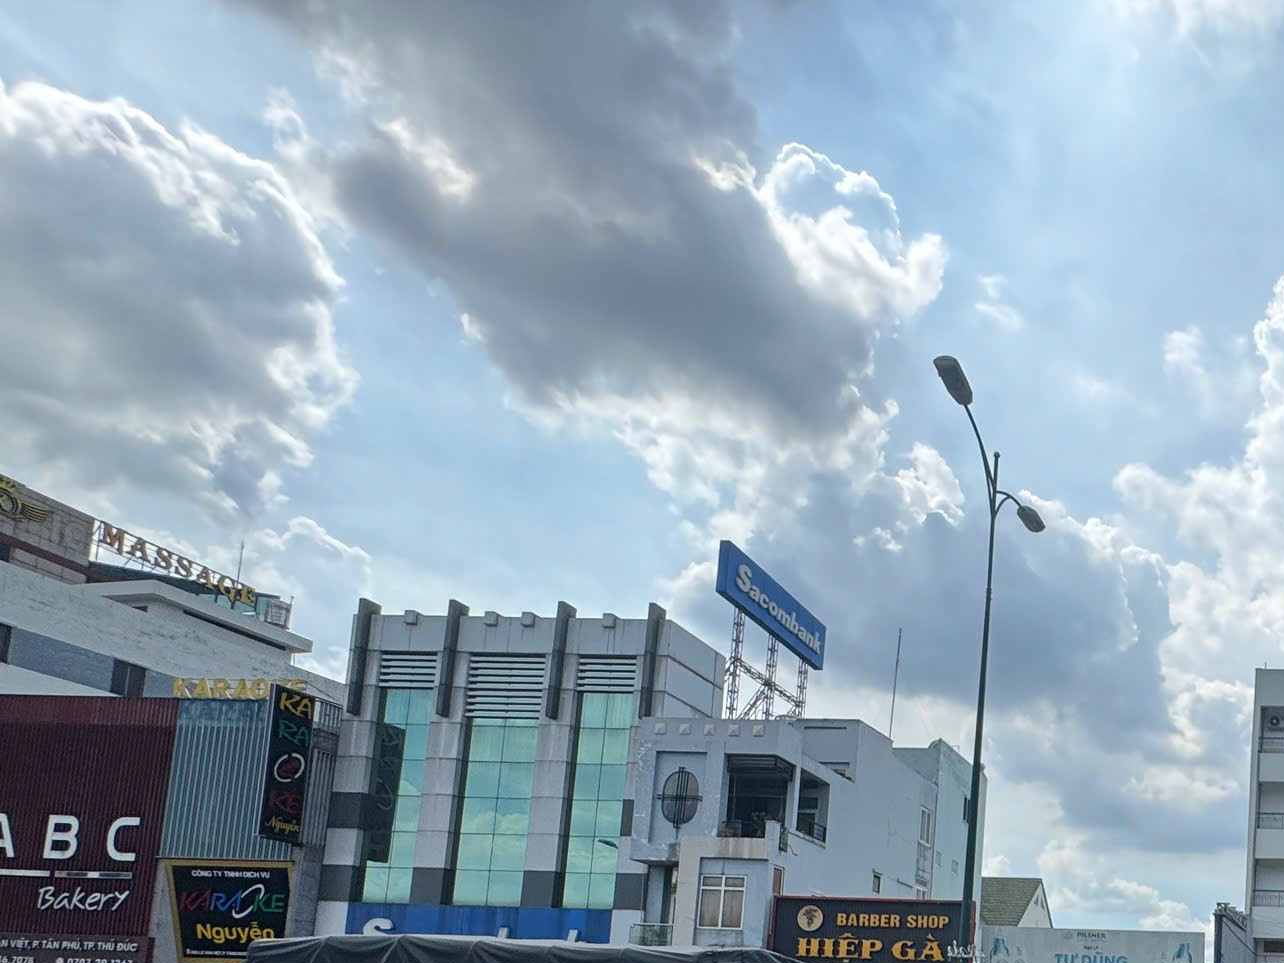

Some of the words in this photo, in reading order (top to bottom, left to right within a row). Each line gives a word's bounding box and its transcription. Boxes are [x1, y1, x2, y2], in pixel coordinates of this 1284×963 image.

[101, 522, 257, 606] MASSAGE
[736, 564, 822, 655] Sacombank
[37, 886, 130, 911] Bakery
[180, 883, 286, 918] KARAOKE
[196, 922, 275, 943] Nguyễn
[837, 913, 900, 928] BARBER
[906, 915, 949, 928] SHOP
[41, 938, 60, 949] TÂN
[796, 932, 883, 963] HIỆP
[891, 933, 944, 962] GÀ
[1077, 931, 1107, 939] PILSNER
